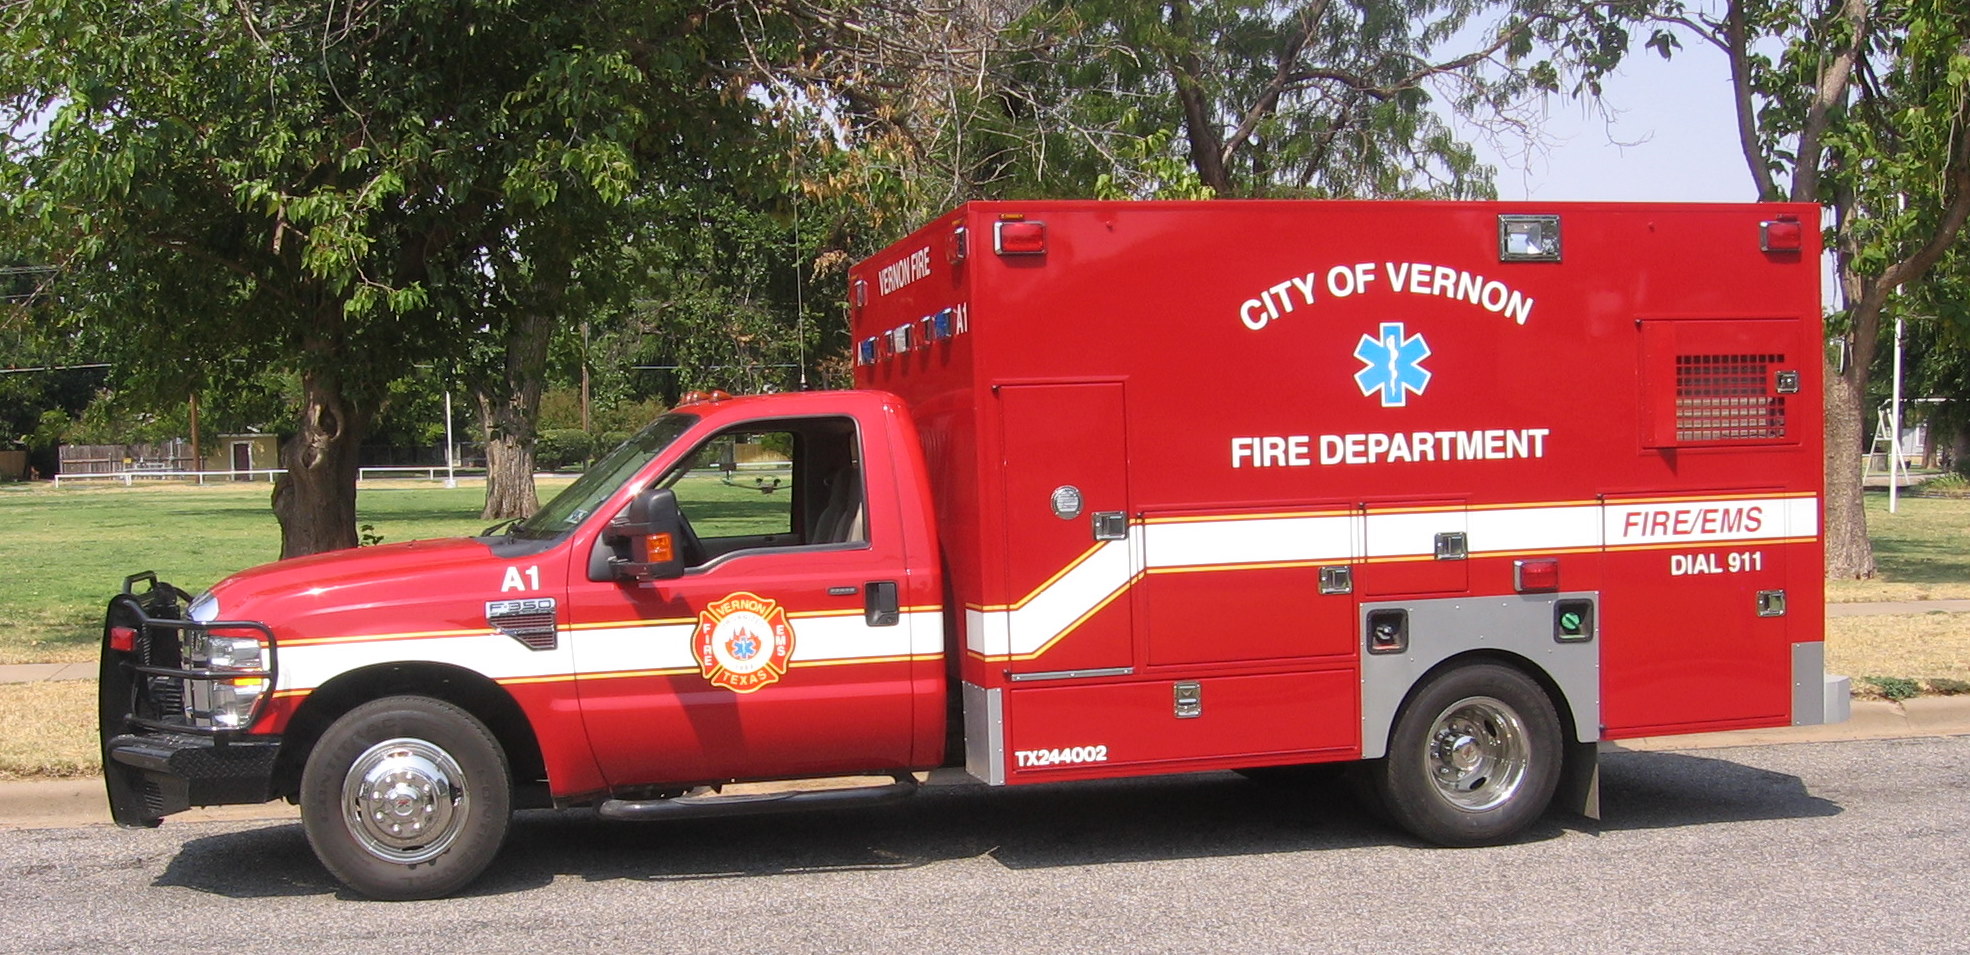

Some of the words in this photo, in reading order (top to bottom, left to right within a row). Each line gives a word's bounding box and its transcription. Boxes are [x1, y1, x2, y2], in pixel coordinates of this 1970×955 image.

[877, 256, 911, 297] VERNON
[911, 246, 931, 282] FIRE
[1239, 272, 1315, 331] CITY
[1326, 262, 1376, 298] OF
[1385, 261, 1534, 326] VERNON
[956, 301, 968, 335] A1
[1231, 435, 1311, 469] FIRE
[1319, 428, 1550, 465] DEPARTMENT
[1623, 506, 1764, 537] FIRE/EMS
[500, 565, 540, 593] A1
[1670, 553, 1723, 576] DIAL
[1727, 551, 1762, 573] 911
[715, 599, 767, 616] VERNON
[702, 623, 713, 667] FIRE
[775, 624, 787, 657] EMS
[722, 669, 767, 686] TEXAS
[1014, 744, 1108, 767] TX244002
